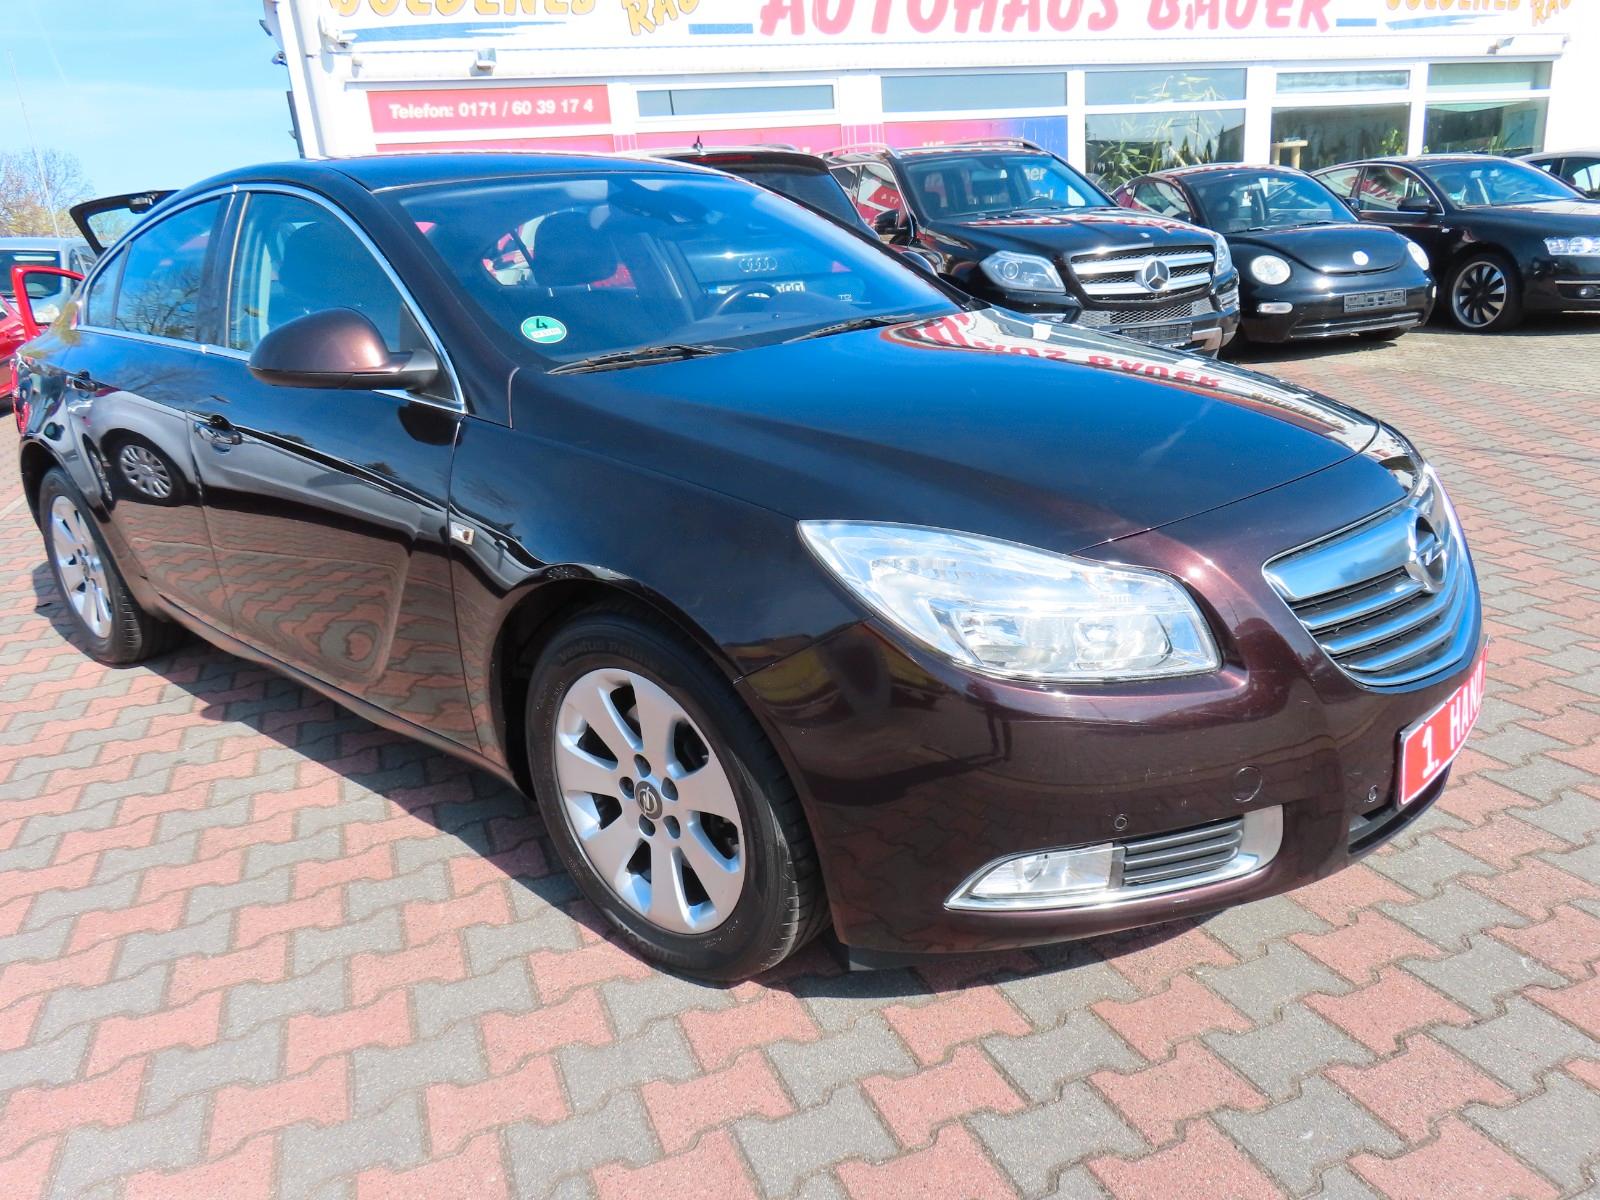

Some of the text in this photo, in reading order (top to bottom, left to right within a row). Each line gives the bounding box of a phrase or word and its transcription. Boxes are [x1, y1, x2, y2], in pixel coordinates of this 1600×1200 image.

[760, 0, 1331, 36] AUTOHAUS BAUER
[389, 98, 595, 119] Telefon: 0171 / 60 39 17 4
[1422, 726, 1440, 779] 1.
